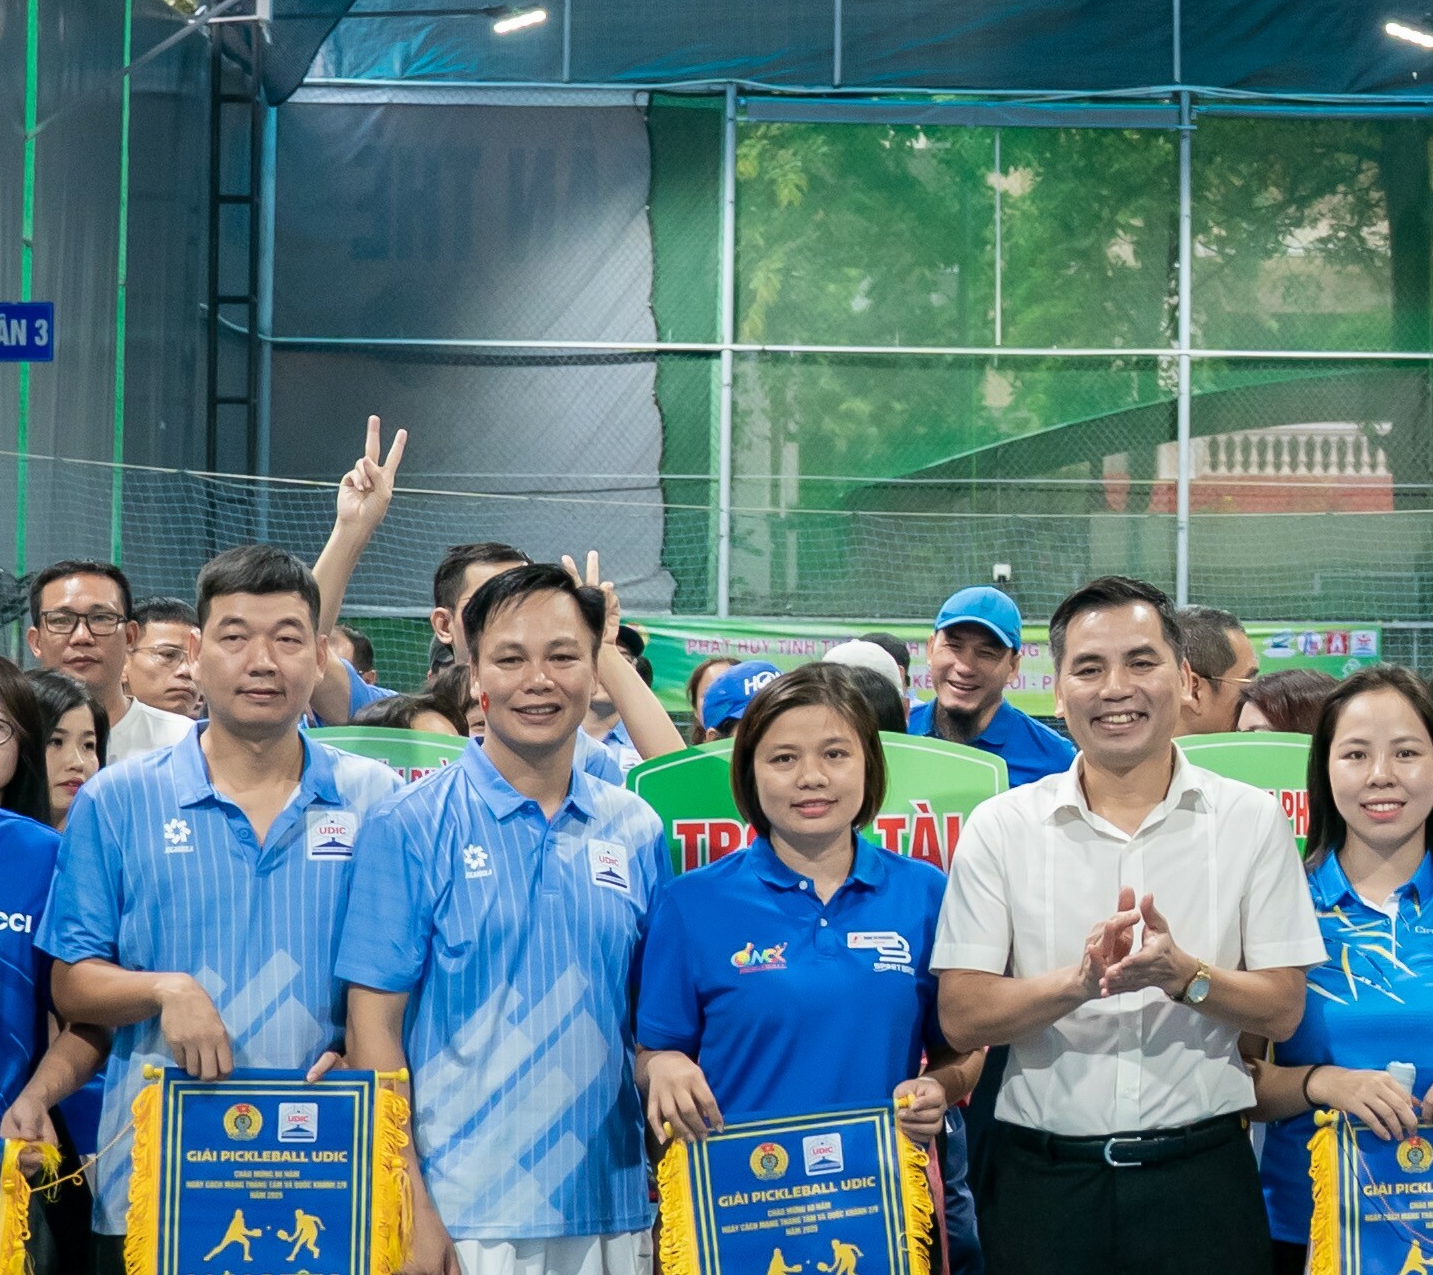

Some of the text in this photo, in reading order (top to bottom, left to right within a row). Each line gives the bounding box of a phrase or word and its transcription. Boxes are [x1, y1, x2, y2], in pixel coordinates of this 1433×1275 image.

[35, 319, 48, 346] 3
[738, 639, 770, 655] HUY
[318, 826, 347, 835] UDIC
[598, 854, 620, 867] UDIC
[186, 1148, 348, 1162] GIẢI PICKLEBALL UDIC
[718, 1176, 876, 1208] GIẢI PICKLEBALL UDIC
[1363, 1181, 1393, 1196] GIẢI
